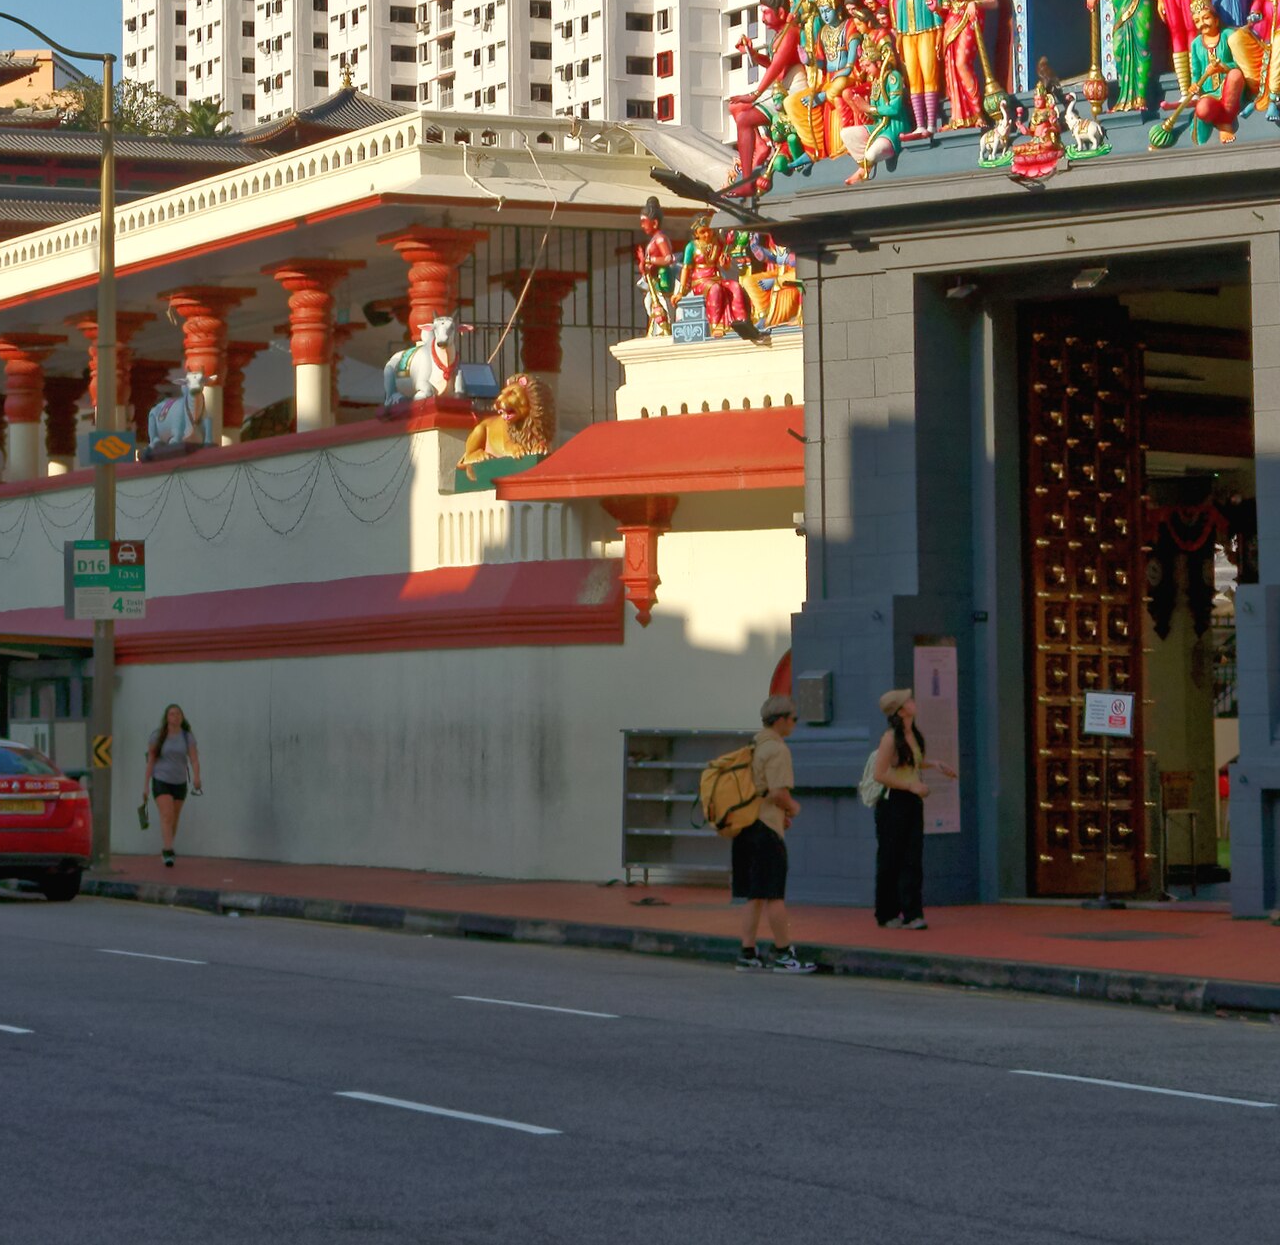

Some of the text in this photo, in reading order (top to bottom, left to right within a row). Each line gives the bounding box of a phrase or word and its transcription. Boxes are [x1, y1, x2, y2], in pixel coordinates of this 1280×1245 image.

[77, 559, 106, 573] D16
[118, 568, 139, 579] Taxi
[112, 597, 124, 614] 4
